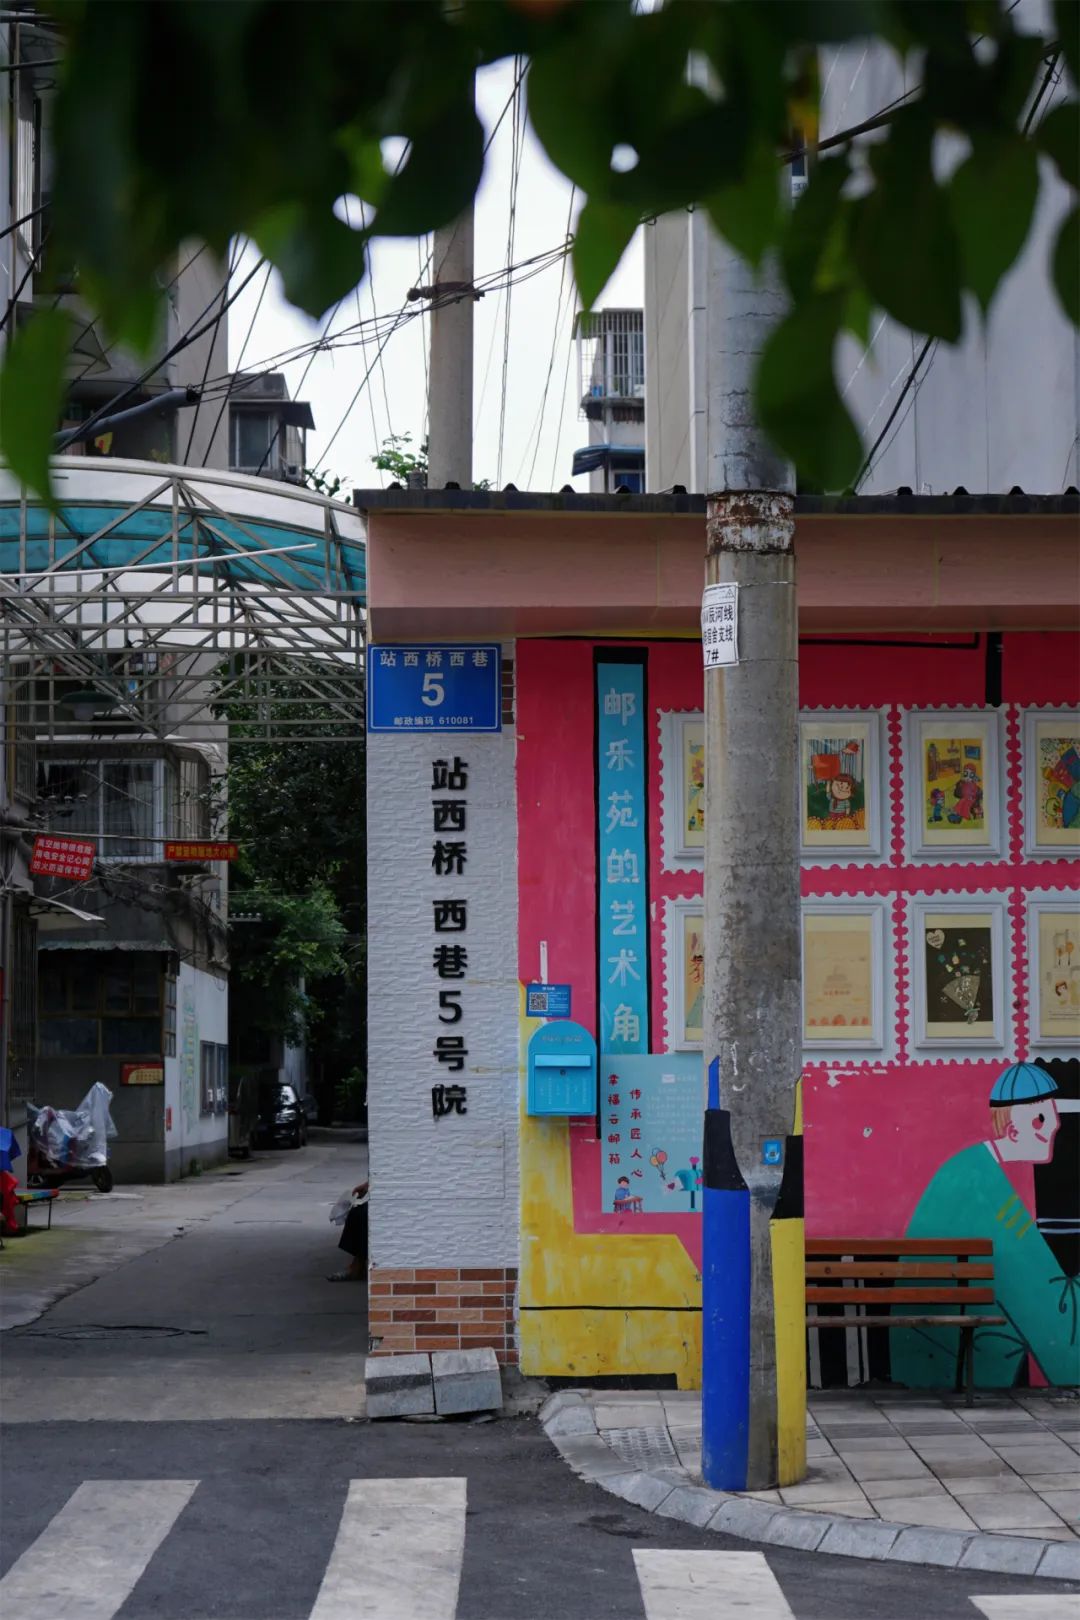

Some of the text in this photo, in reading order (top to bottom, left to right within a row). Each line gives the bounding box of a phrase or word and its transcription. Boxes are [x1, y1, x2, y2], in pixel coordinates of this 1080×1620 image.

[379, 650, 489, 668] 站西桥西巷
[705, 647, 720, 665] 7#
[421, 672, 445, 707] 5
[393, 716, 473, 726] 邮政编码 610081
[604, 687, 641, 1043] 邮乐苑的艺术角
[607, 1073, 621, 1166] 幸福云邮箱
[629, 1087, 643, 1178] 传承匠人心
